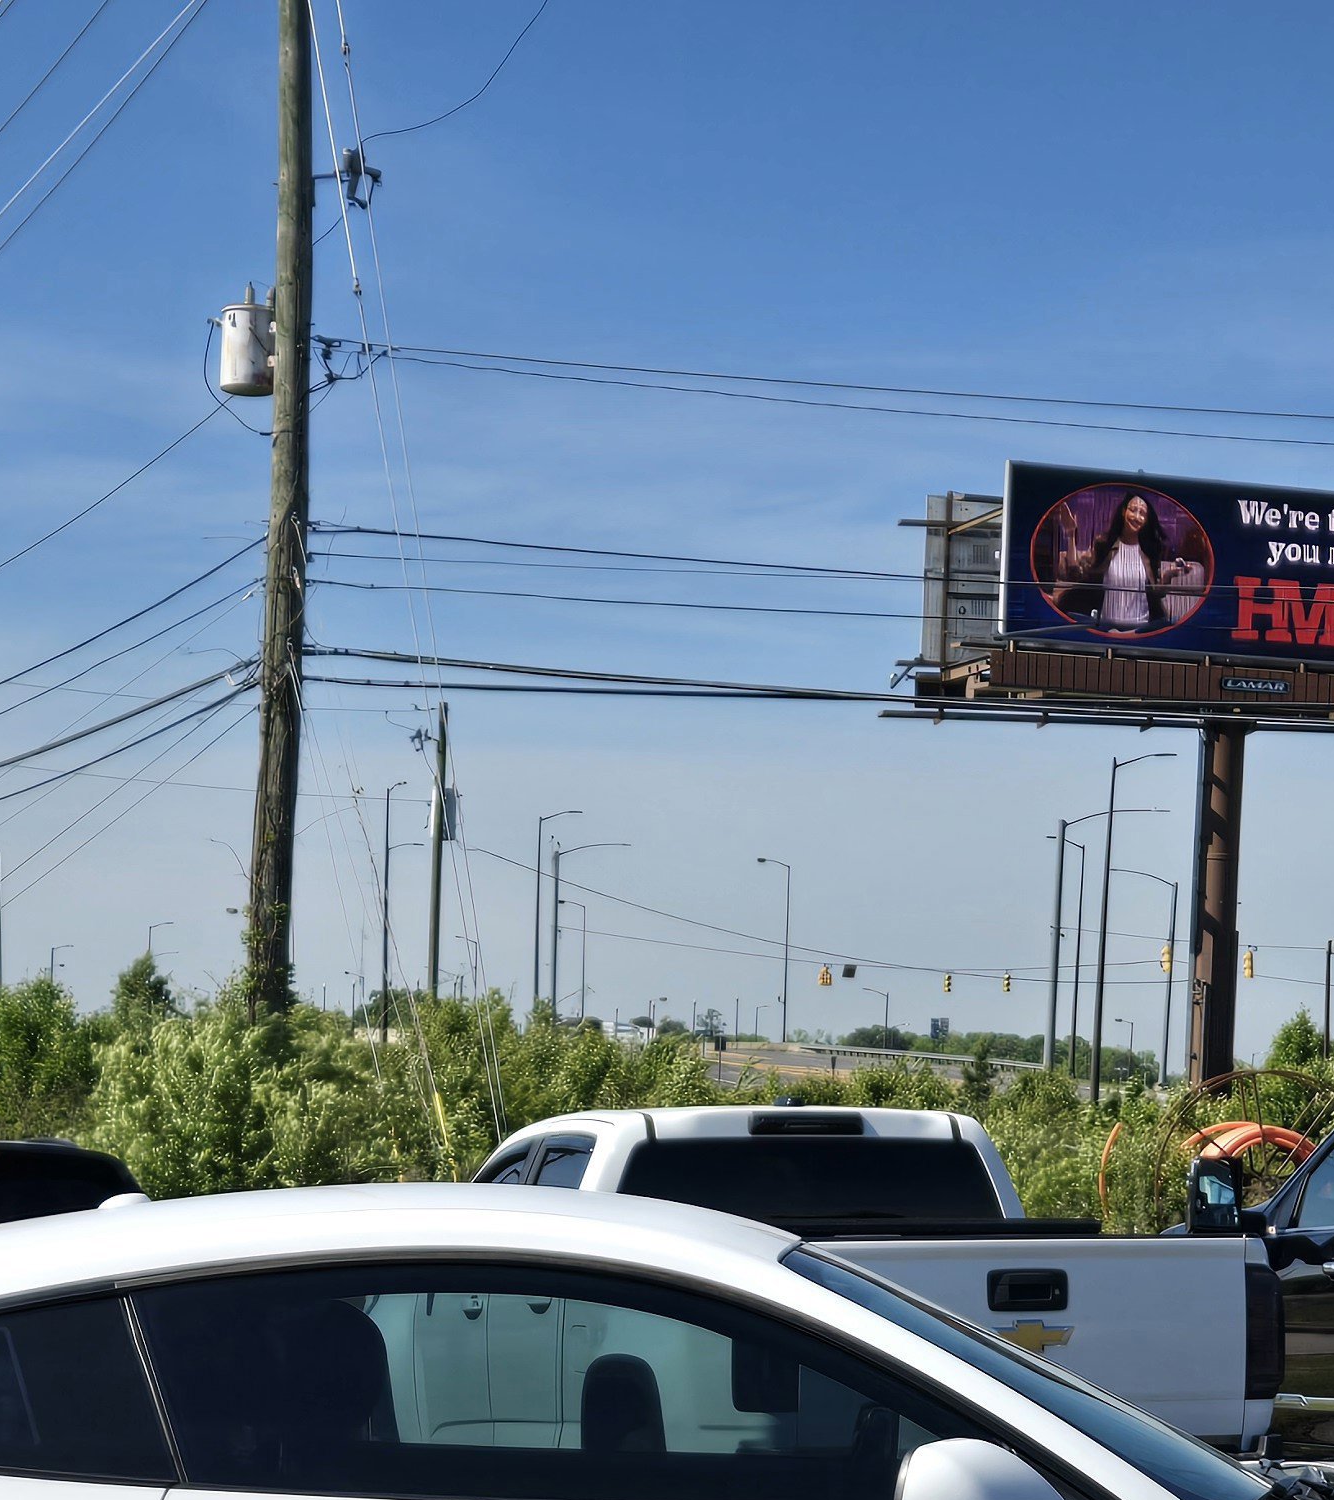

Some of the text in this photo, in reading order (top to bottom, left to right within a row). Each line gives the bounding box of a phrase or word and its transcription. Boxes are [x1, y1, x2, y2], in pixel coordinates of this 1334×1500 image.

[1238, 500, 1320, 531] We're
[1267, 541, 1320, 567] you
[1227, 679, 1286, 691] LAMAR
